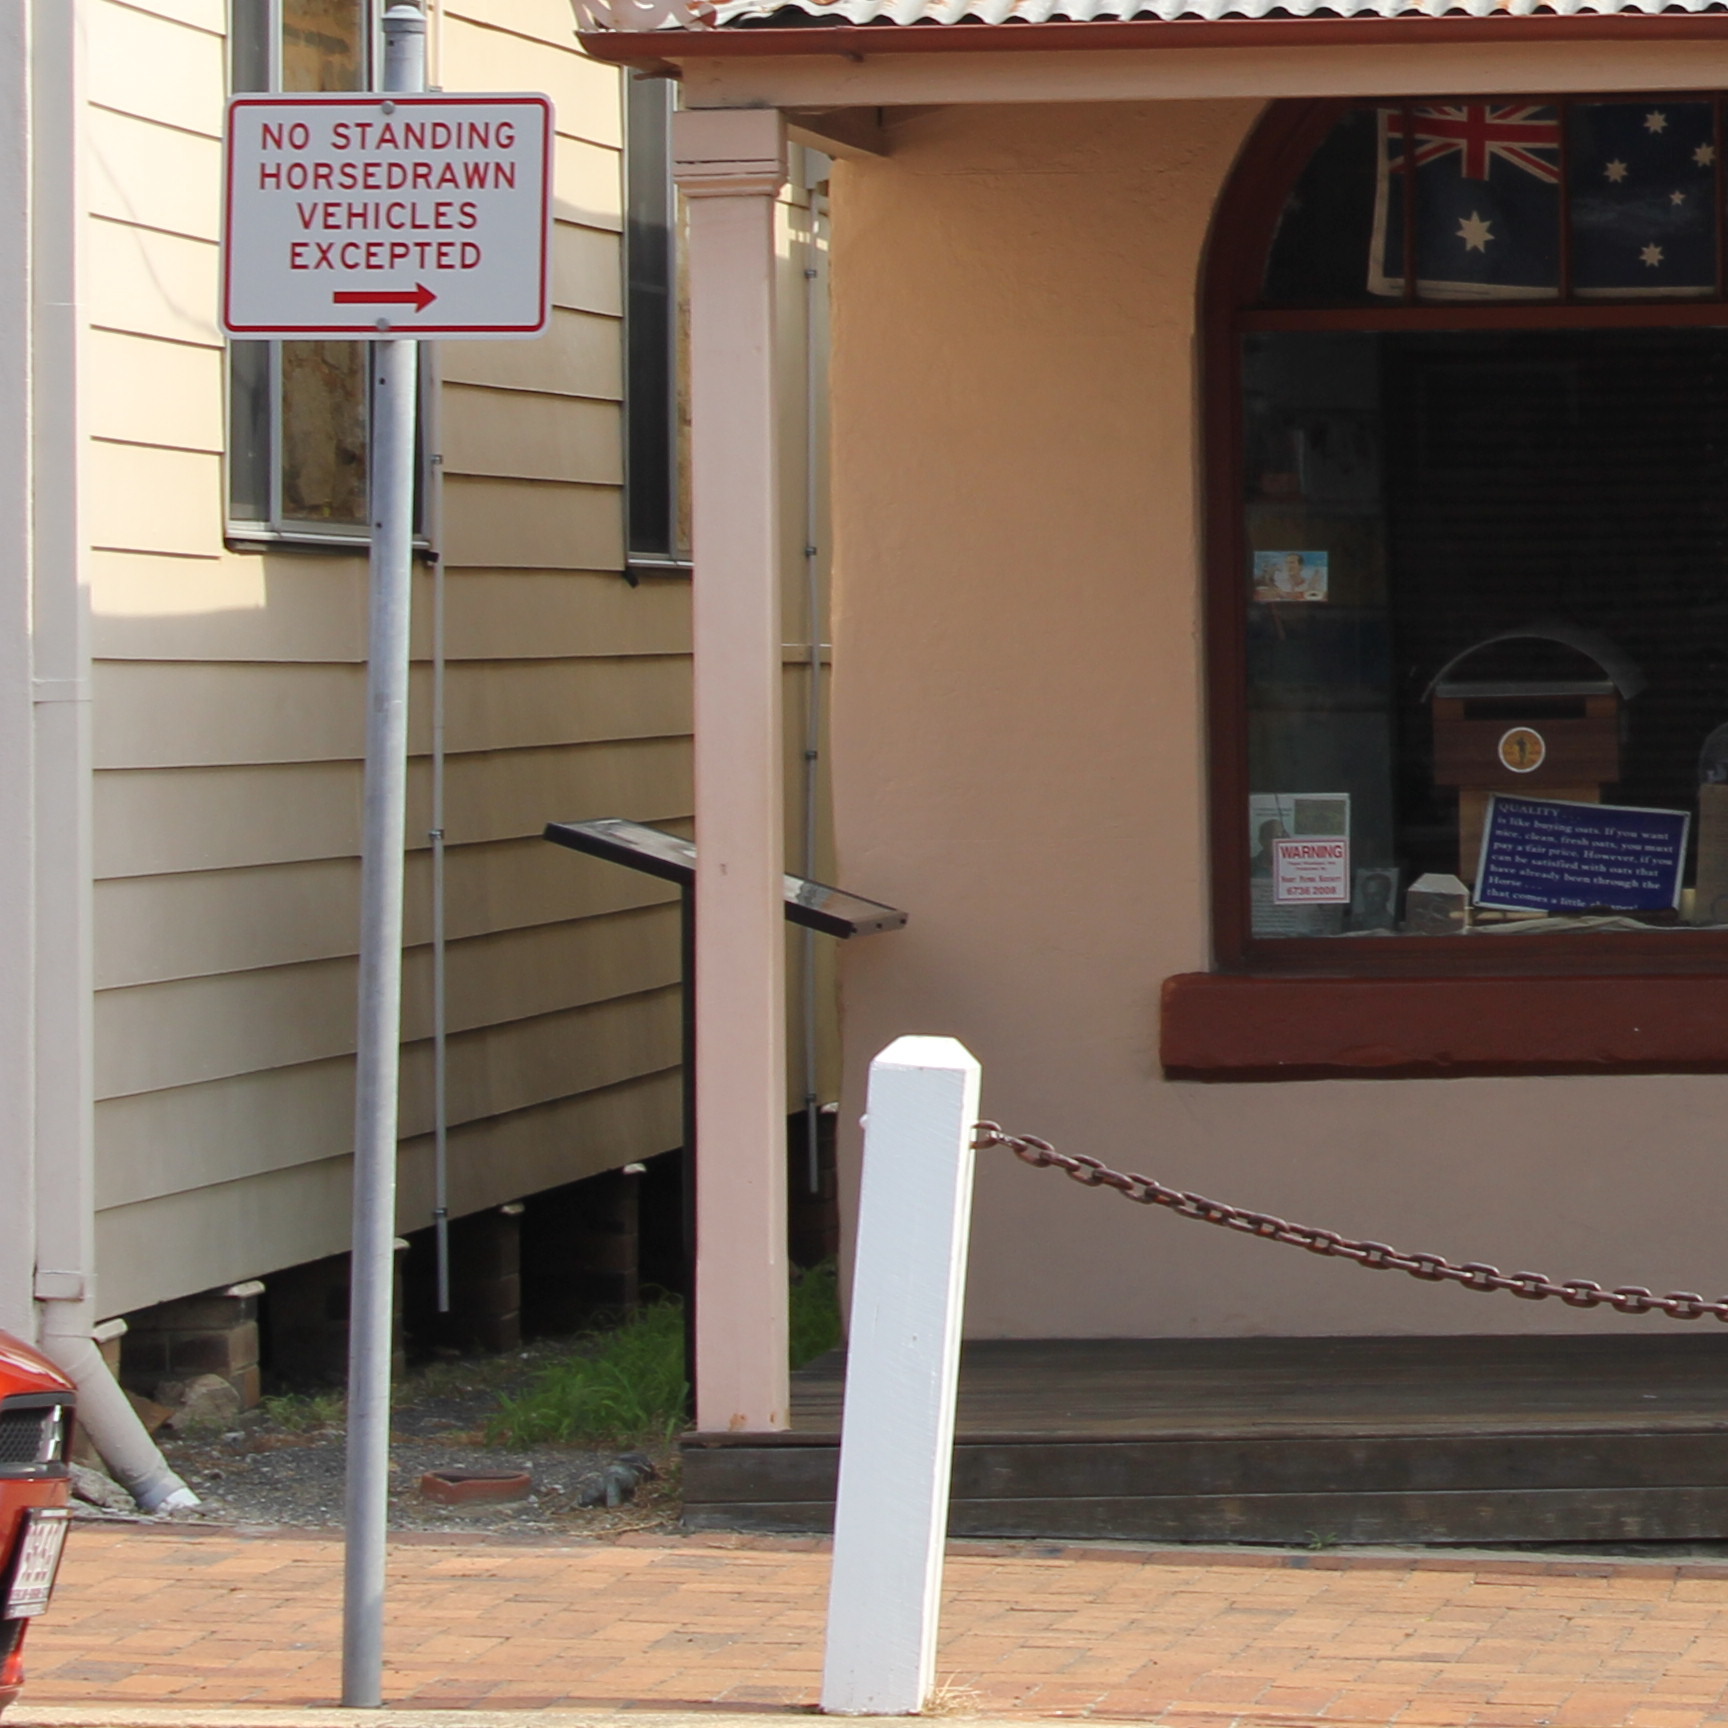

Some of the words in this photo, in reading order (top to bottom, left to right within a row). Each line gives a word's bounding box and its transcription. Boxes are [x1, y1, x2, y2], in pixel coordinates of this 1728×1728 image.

[261, 122, 311, 151] NO
[330, 122, 517, 150] STANDING
[259, 161, 517, 190] HORSEDRAWN
[297, 201, 479, 230] VEHICLES
[289, 241, 482, 270] EXCEPTED
[1498, 802, 1560, 817] QUALITY
[1495, 829, 1520, 840] nice,
[1524, 832, 1556, 843] clean,
[1560, 836, 1589, 847] fresh
[1591, 840, 1618, 850] oats,
[1620, 843, 1640, 852] you
[1644, 845, 1673, 854] must
[1509, 817, 1530, 828] like
[1533, 820, 1572, 834] buying
[1575, 825, 1600, 835] oats.
[1616, 830, 1637, 840] you
[1641, 832, 1669, 841] want
[1280, 845, 1343, 859] WARNING
[1493, 842, 1513, 852] pay
[1524, 843, 1546, 854] fair
[1548, 847, 1579, 858] price.
[1583, 850, 1638, 863] However,
[1651, 857, 1673, 867] you
[1489, 864, 1516, 875] have
[1519, 867, 1560, 882] already
[1563, 873, 1591, 884] been
[1593, 876, 1639, 889] through
[1642, 880, 1661, 890] the
[1491, 854, 1512, 863] can
[1531, 857, 1579, 870] satisfied
[1580, 862, 1607, 873] with
[1609, 866, 1633, 876] oats
[1635, 867, 1659, 877] that
[1488, 876, 1523, 887] Horse
[1486, 888, 1510, 899] that
[1512, 893, 1548, 903] comes
[1560, 896, 1586, 907] little
